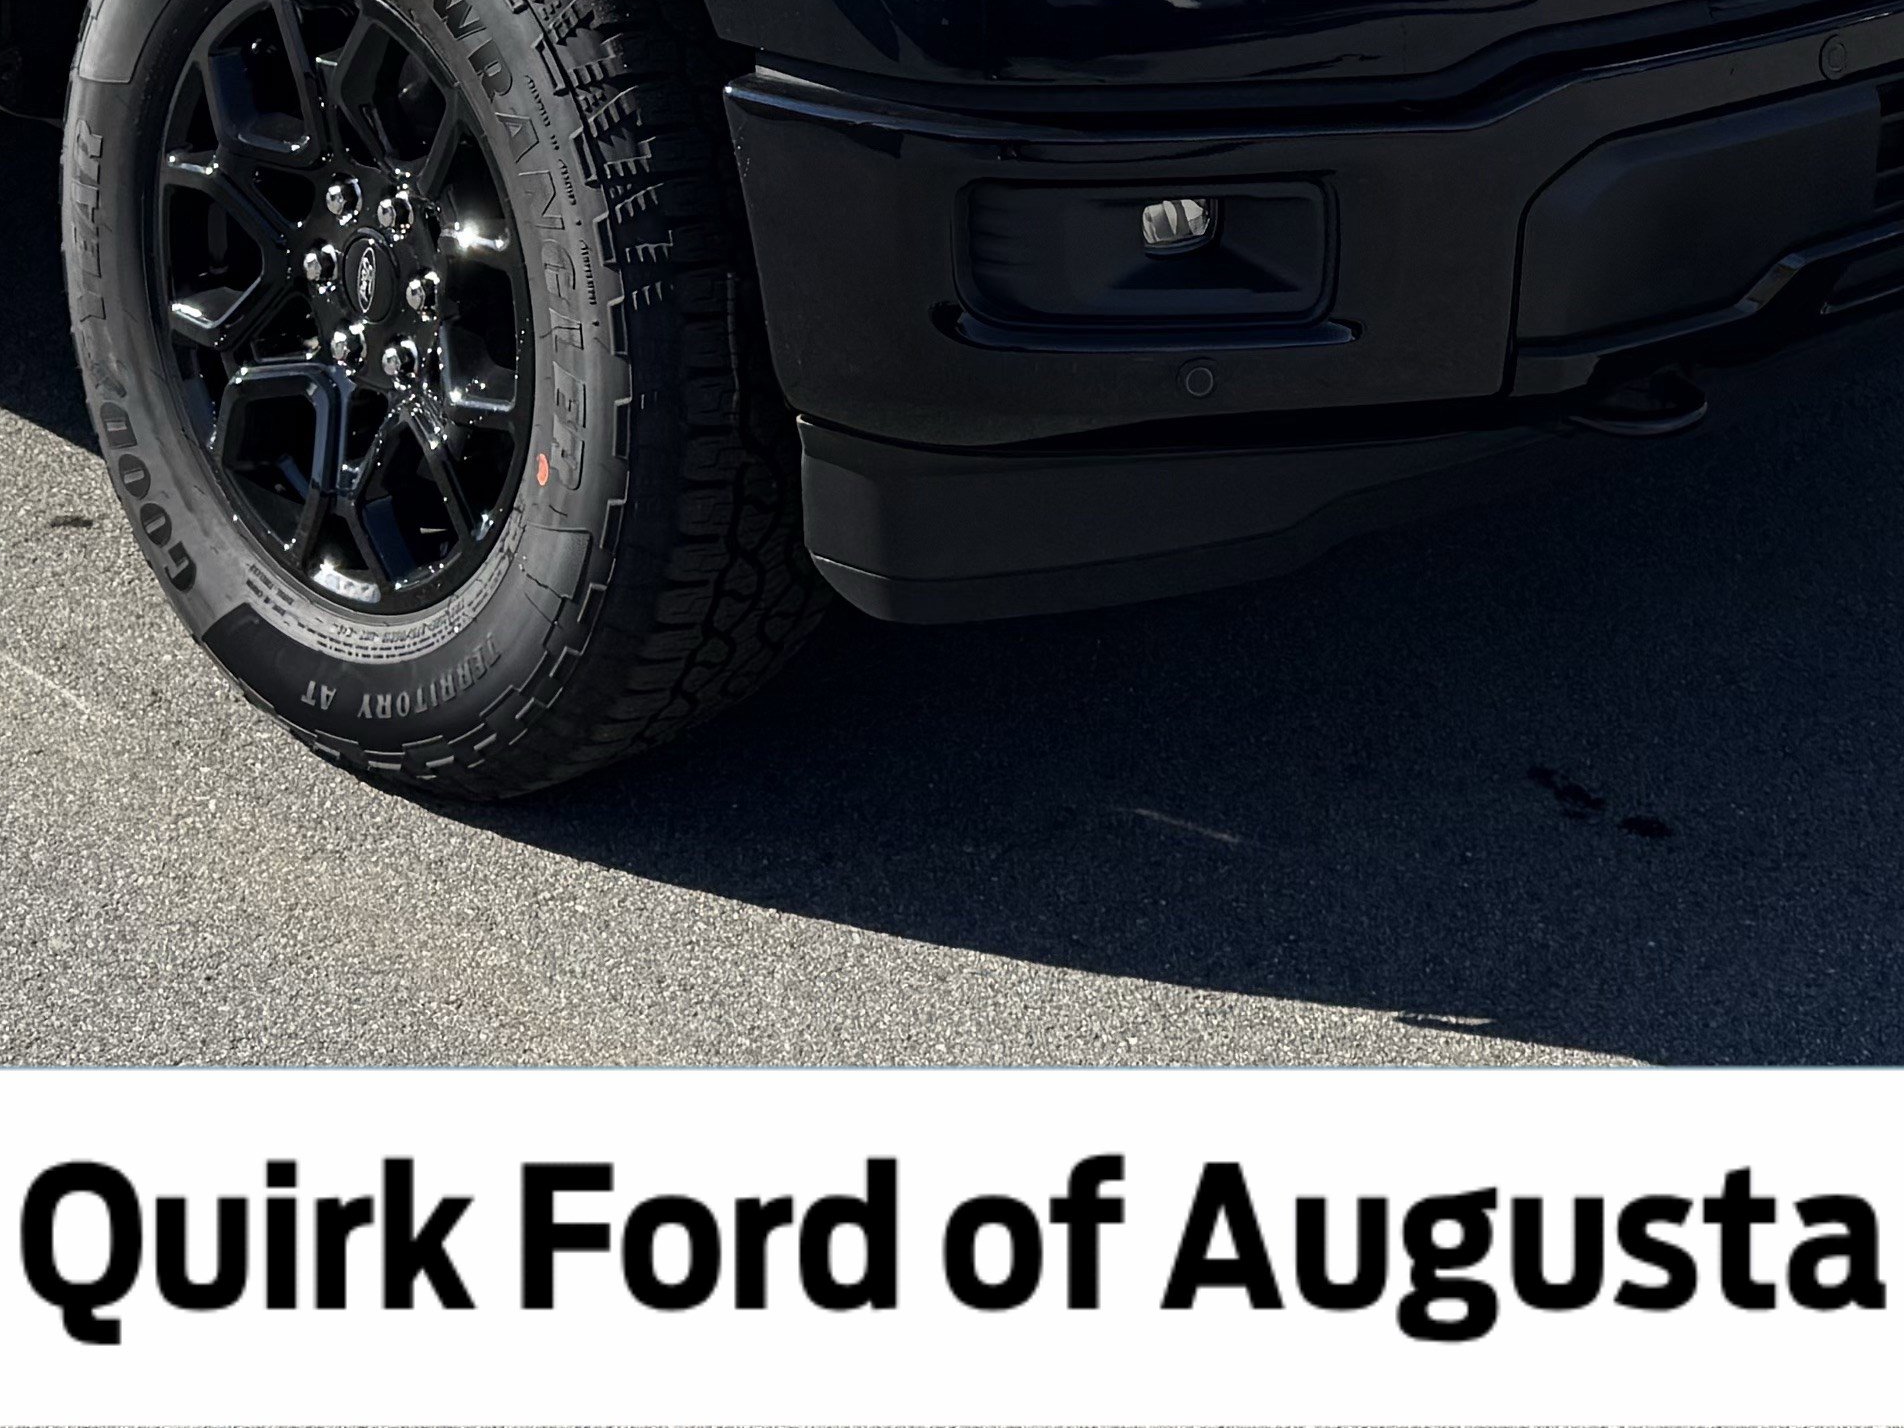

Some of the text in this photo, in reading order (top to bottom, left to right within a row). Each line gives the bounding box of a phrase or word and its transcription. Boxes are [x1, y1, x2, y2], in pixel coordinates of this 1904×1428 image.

[74, 118, 196, 593] GOODYEAR
[300, 631, 502, 719] TERRITORY AT
